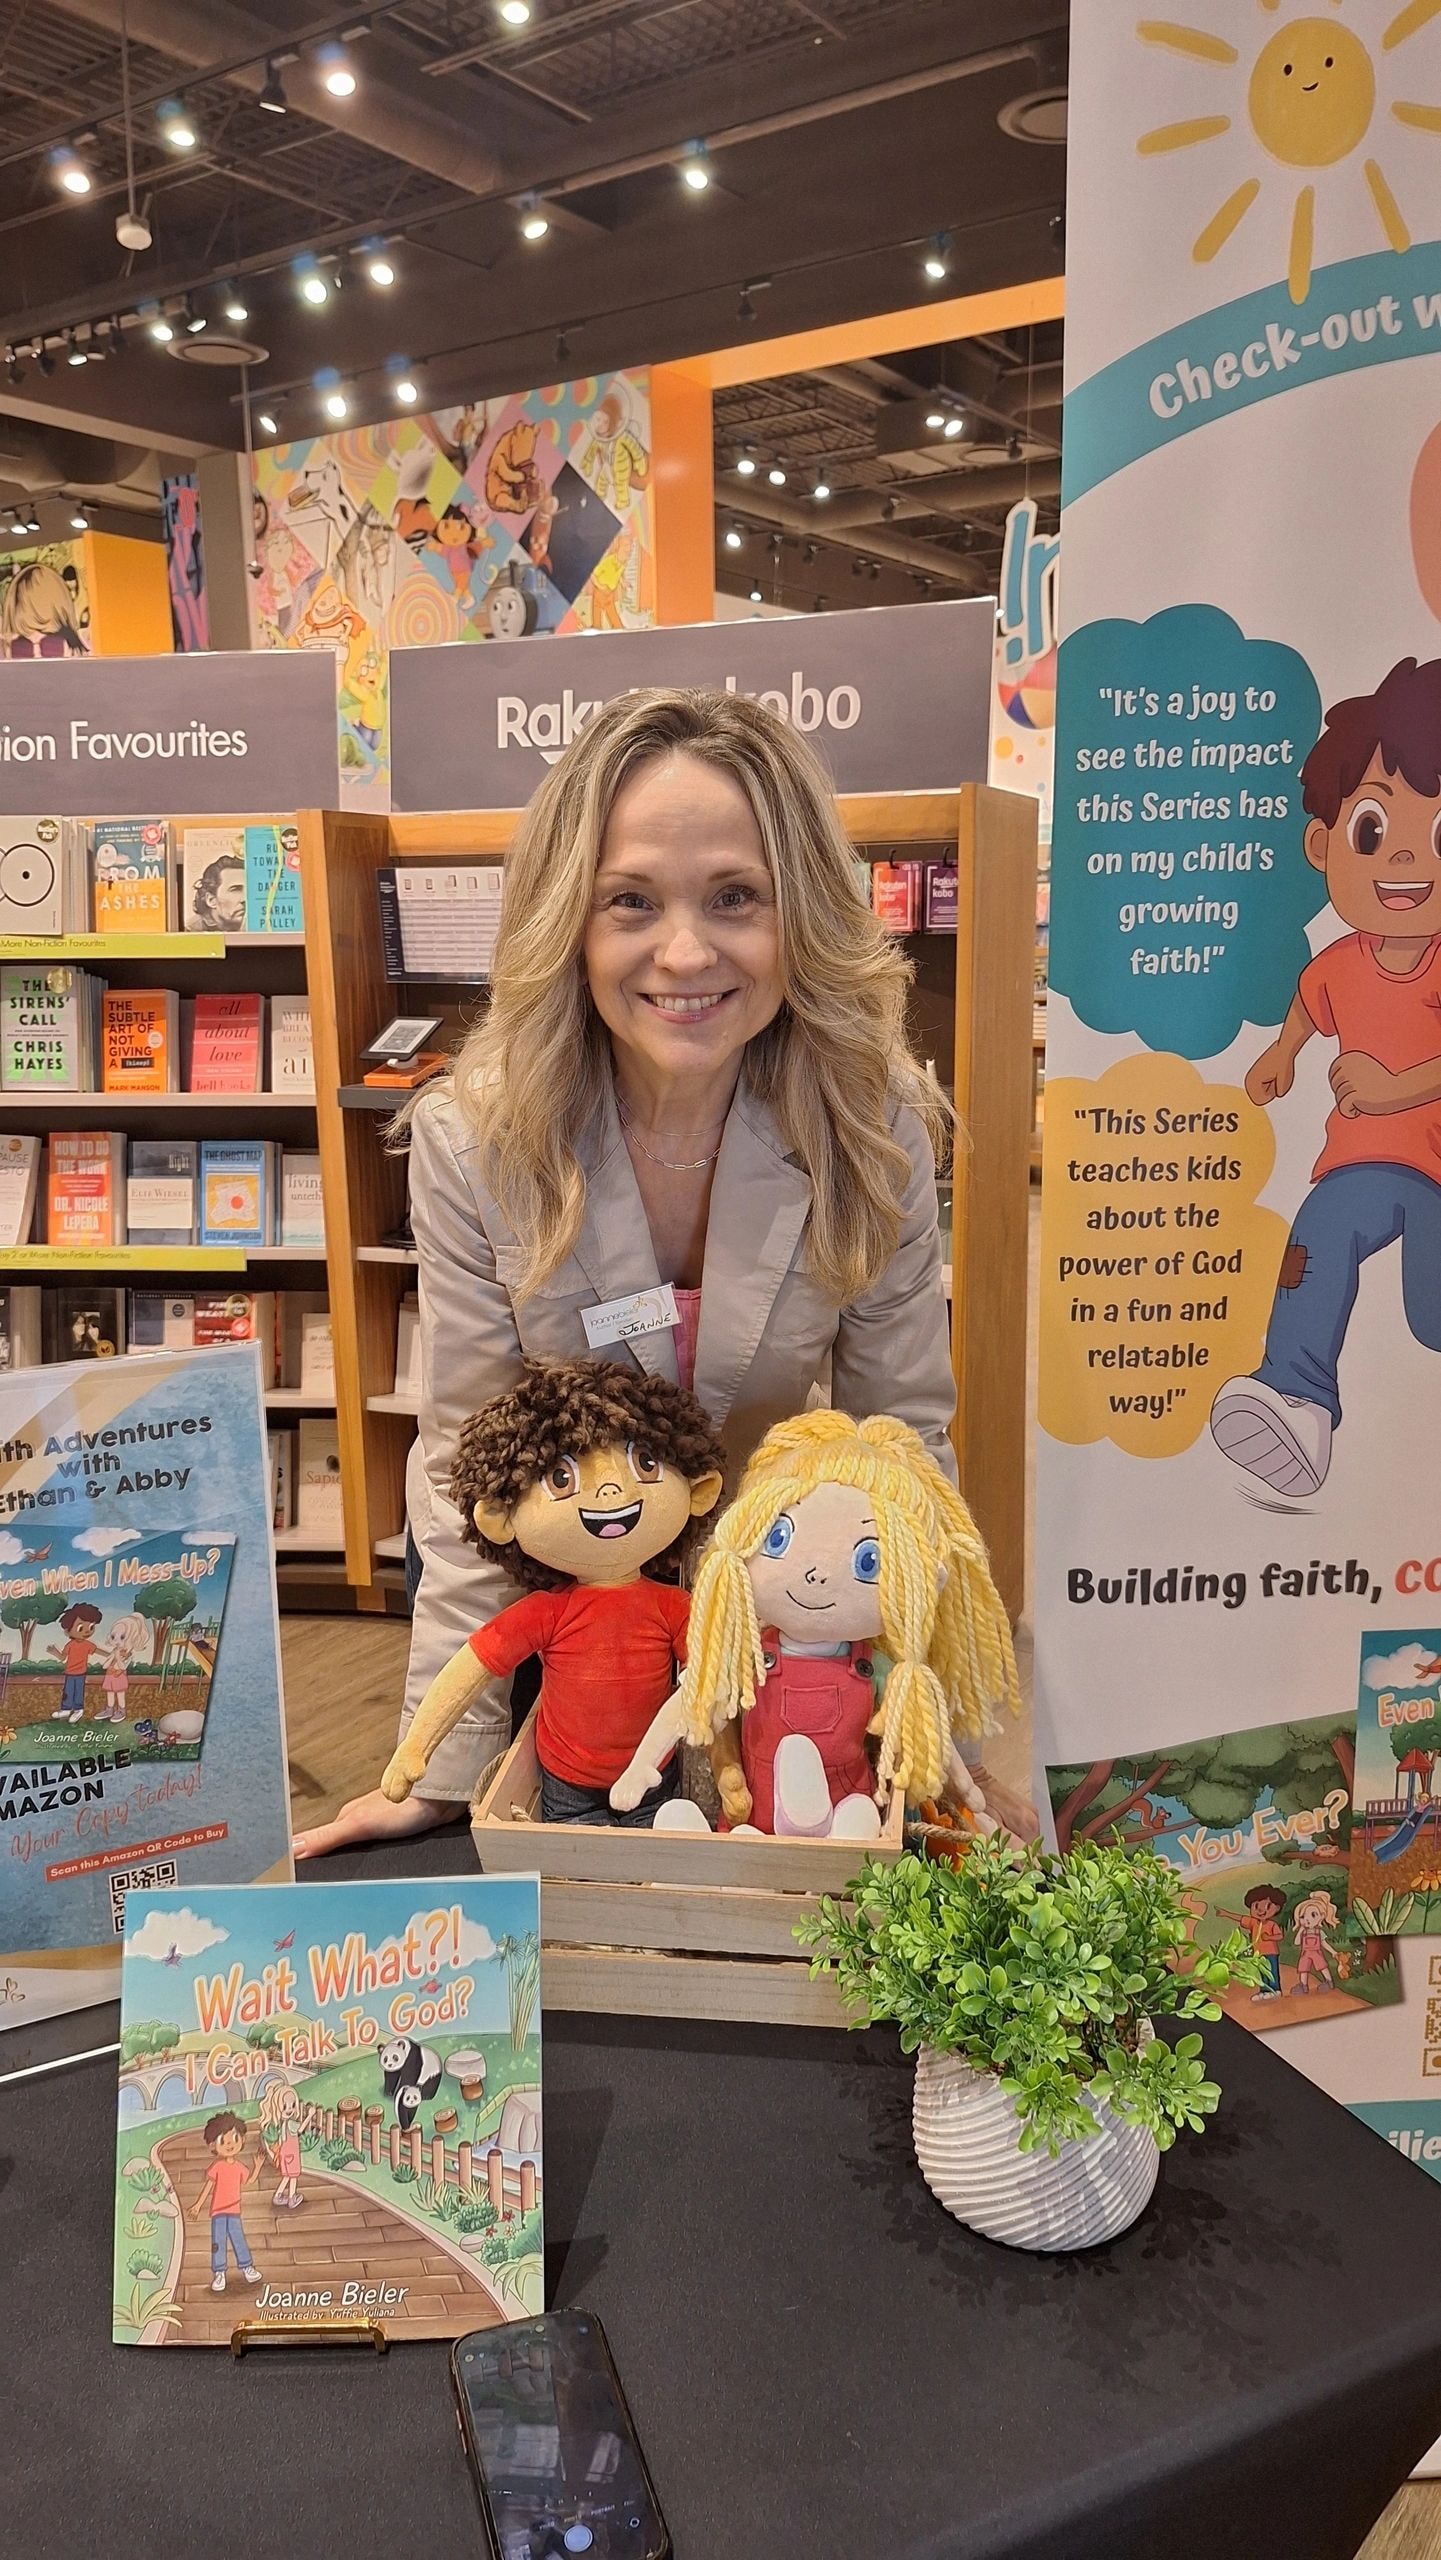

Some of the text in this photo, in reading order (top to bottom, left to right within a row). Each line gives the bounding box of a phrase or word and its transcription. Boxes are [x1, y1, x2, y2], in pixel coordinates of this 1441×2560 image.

[1149, 295, 1402, 418] Check-out
[1167, 692, 1183, 715] a
[1187, 685, 1236, 721] joy
[1245, 687, 1276, 711] to
[71, 720, 248, 760] Favourites
[1076, 739, 1293, 773] see the impact
[1077, 790, 1288, 822] this Series has
[1088, 843, 1274, 879] on my child's
[100, 895, 160, 911] ASHES
[932, 888, 954, 898] kobo
[1119, 896, 1239, 932] growing
[108, 1001, 132, 1011] THE
[108, 1012, 156, 1023] SUBTLE
[218, 1000, 241, 1016] all
[19, 1014, 57, 1026] CALL
[109, 1023, 154, 1034] ART OF
[205, 1023, 250, 1039] about
[14, 1041, 63, 1053] CHRIS
[109, 1035, 135, 1045] NOT
[109, 1046, 152, 1057] GIVING
[15, 1058, 63, 1070] HAYES
[109, 1058, 117, 1069] A
[209, 1046, 243, 1062] love
[1153, 1107, 1239, 1135] Series
[55, 1141, 110, 1155] HOW TO DO
[205, 1150, 219, 1161] THE
[57, 1160, 107, 1175] THE WORK
[1068, 1155, 1242, 1183] teaches kids
[54, 1196, 108, 1211] DR. NICOLE
[1087, 1203, 1220, 1230] about the
[1059, 1249, 1242, 1281] power of God
[1071, 1296, 1228, 1323] in a fun and
[1088, 1343, 1209, 1368] relatable
[44, 1416, 212, 1456] Adventures
[58, 1452, 120, 1479] with
[85, 1480, 106, 1498] &
[116, 1468, 193, 1495] Abby
[41, 1565, 98, 1596] When
[104, 1561, 112, 1587] I
[118, 1548, 221, 1586] Mess-Up?
[1067, 1566, 1246, 1609] Building
[1260, 1560, 1382, 1604] faith,
[1378, 1693, 1434, 1728] Even
[34, 1731, 120, 1742] Joanne Bieler
[11, 1829, 65, 1864] Your
[76, 1804, 129, 1838] Copy
[1179, 1789, 1349, 1867] You Ever?
[50, 1827, 225, 1877] Scan this Amazon QR Code to Buy
[194, 1905, 464, 2036] Wait What?!
[185, 1975, 475, 2093] I Can Talk To God?
[256, 2281, 410, 2309] Joanne Bieler
[260, 2307, 395, 2321] Illustrated by Yuffie Yuliana
